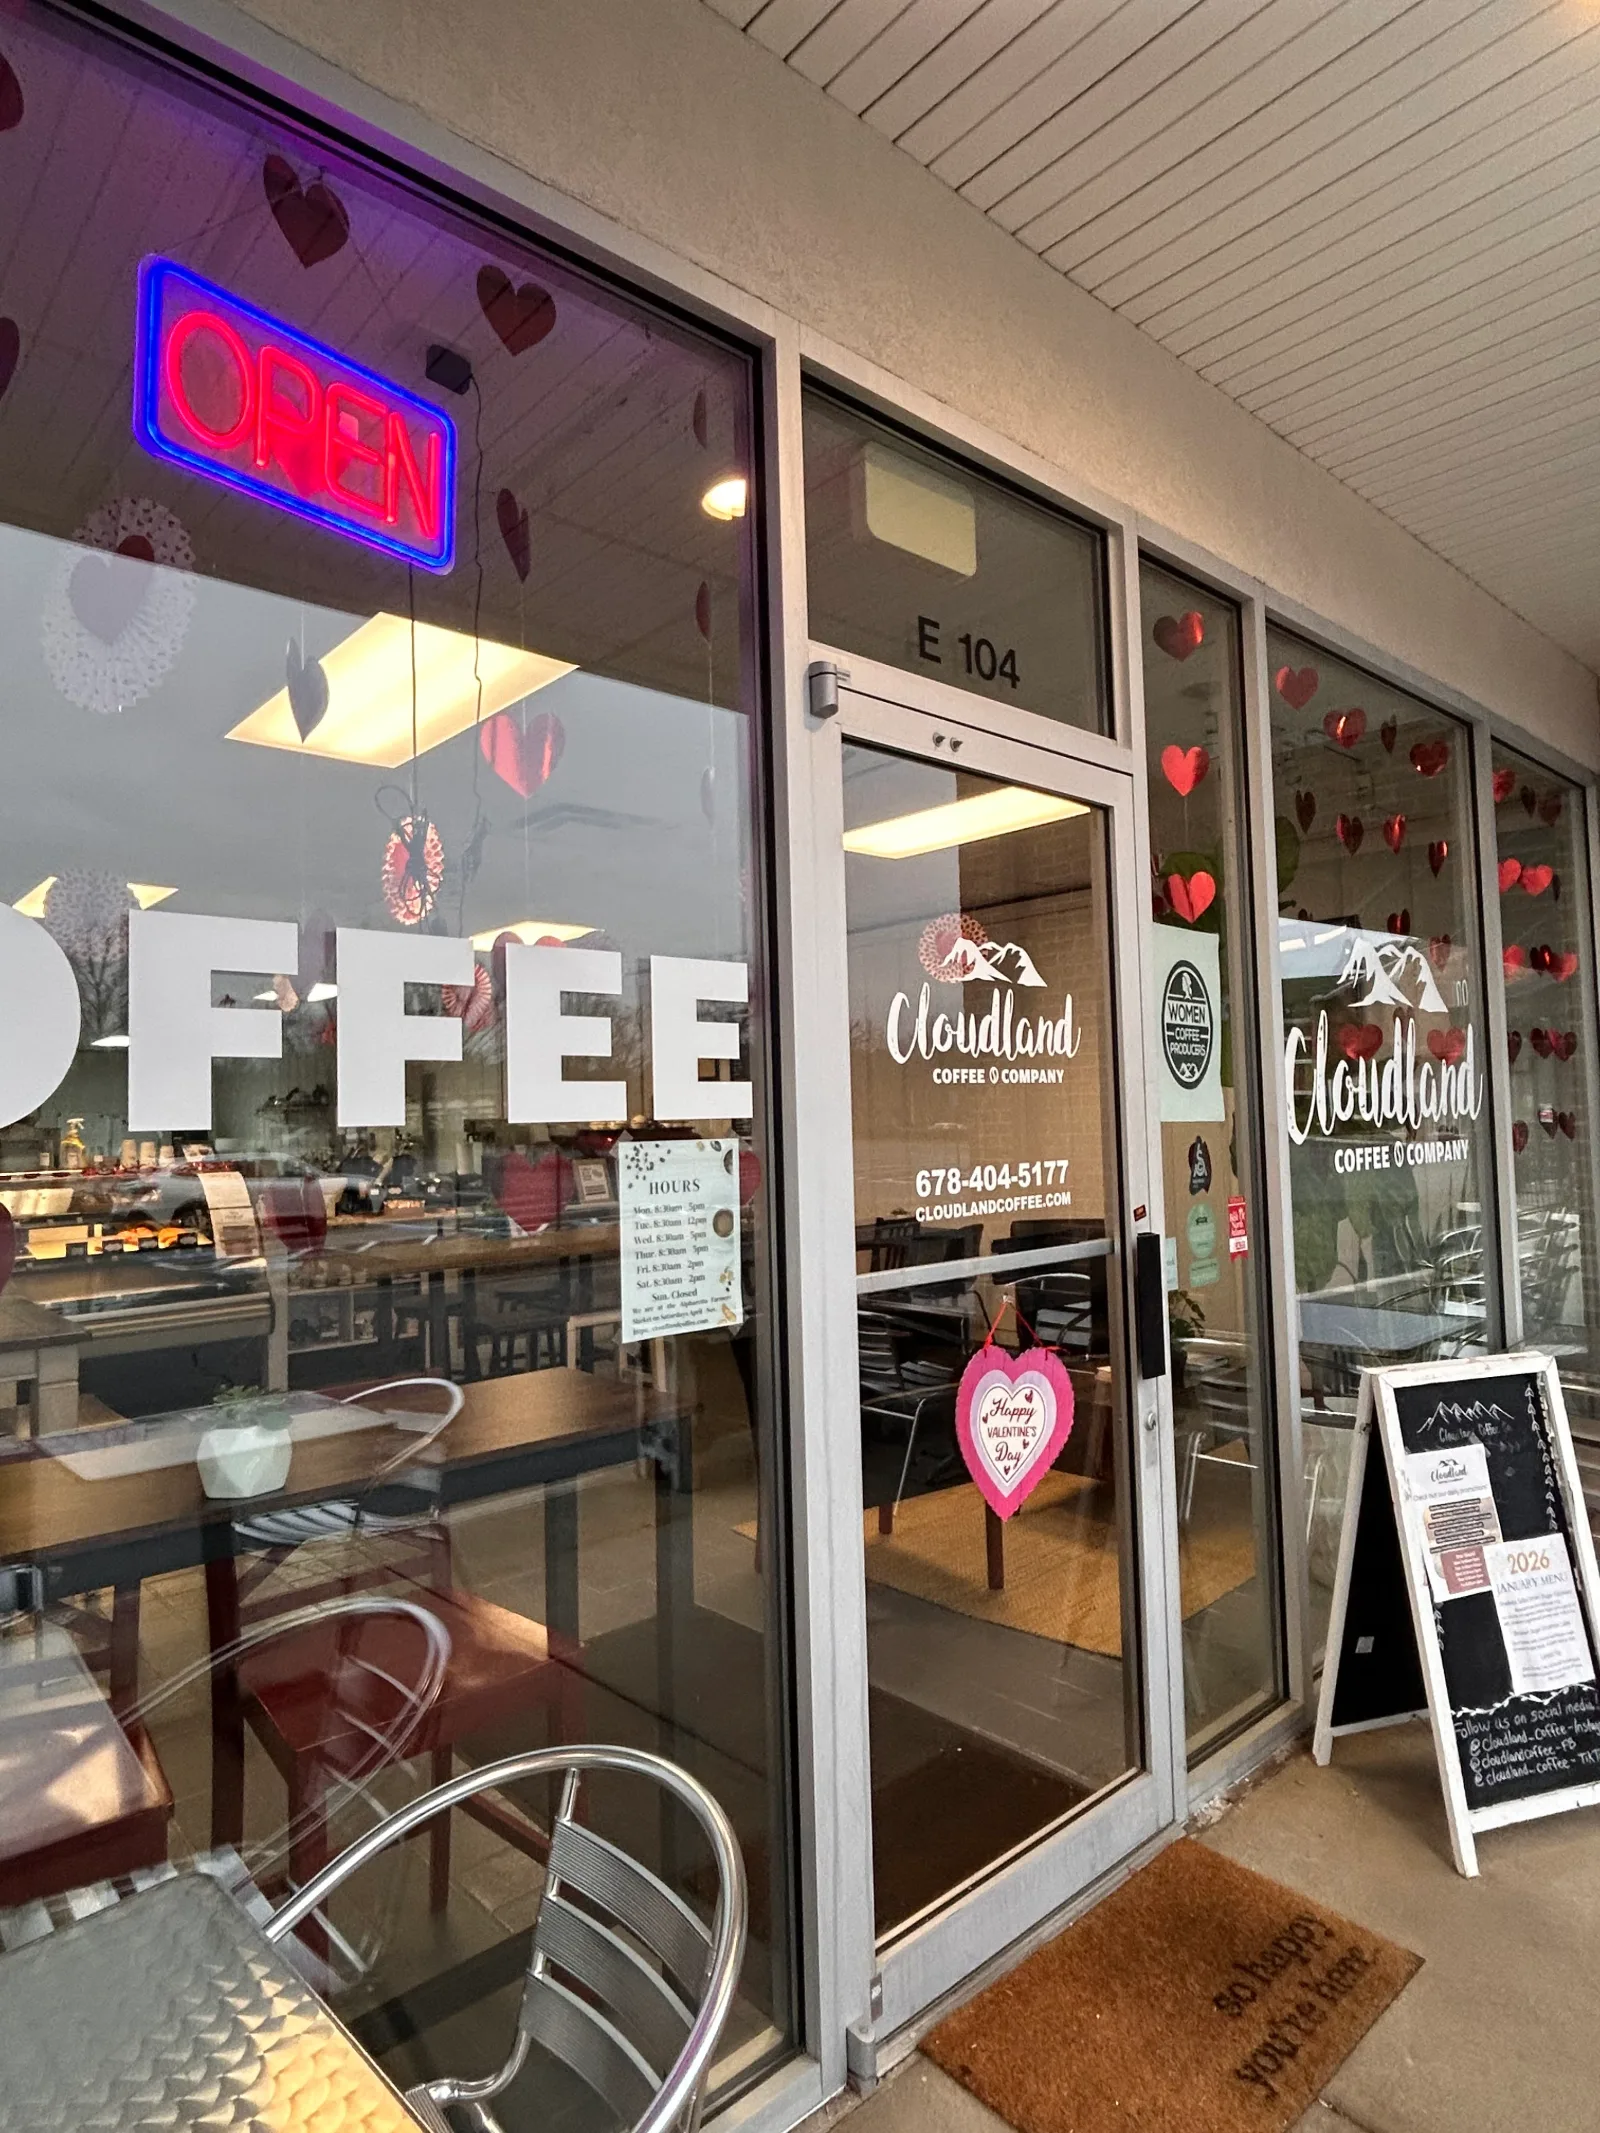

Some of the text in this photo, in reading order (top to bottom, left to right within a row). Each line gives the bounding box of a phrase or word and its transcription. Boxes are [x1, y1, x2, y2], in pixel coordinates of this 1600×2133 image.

[165, 310, 442, 539] OPEN
[918, 615, 1021, 689] E 104
[886, 982, 1082, 1064] Cloudland
[1168, 1002, 1206, 1024] WOMEN
[1175, 1027, 1200, 1042] COFFEE
[1170, 1042, 1206, 1056] PRODUCERS
[933, 1068, 1065, 1085] COFFEE COMPANY
[1285, 1010, 1484, 1145] Cloudland
[1334, 1139, 1469, 1174] COFFEE COMPANY
[650, 1179, 700, 1195] HOURS
[916, 1159, 1069, 1197] 678-404-5177
[655, 1204, 682, 1213] 8:30am
[688, 1202, 705, 1212] 5pm
[915, 1191, 1071, 1222] CLOUDLANDCOFFEE.COM
[635, 1221, 653, 1230] Tue.
[653, 1219, 682, 1228] 8:30am
[634, 1231, 707, 1244] Wed. 8:30am 5pm
[635, 1245, 709, 1260] Thur. 8:30am 5pm
[636, 1260, 704, 1275] Fri. 8:30am 2pm
[637, 1274, 705, 1289] Sat. 8:30am 2pm
[652, 1288, 698, 1301] Sun. Closed
[989, 1397, 1037, 1425] Happy
[987, 1425, 1037, 1439] VALENTINE'S
[995, 1441, 1024, 1469] Day
[1507, 1549, 1551, 1575] 2026
[1495, 1577, 1539, 1597] JANUARY
[1453, 1720, 1491, 1739] Follow
[1494, 1716, 1511, 1730] us
[1514, 1714, 1528, 1726] on
[1530, 1702, 1562, 1723] social
[1212, 1910, 1335, 2018] so happy
[1235, 1945, 1383, 2100] you're here
